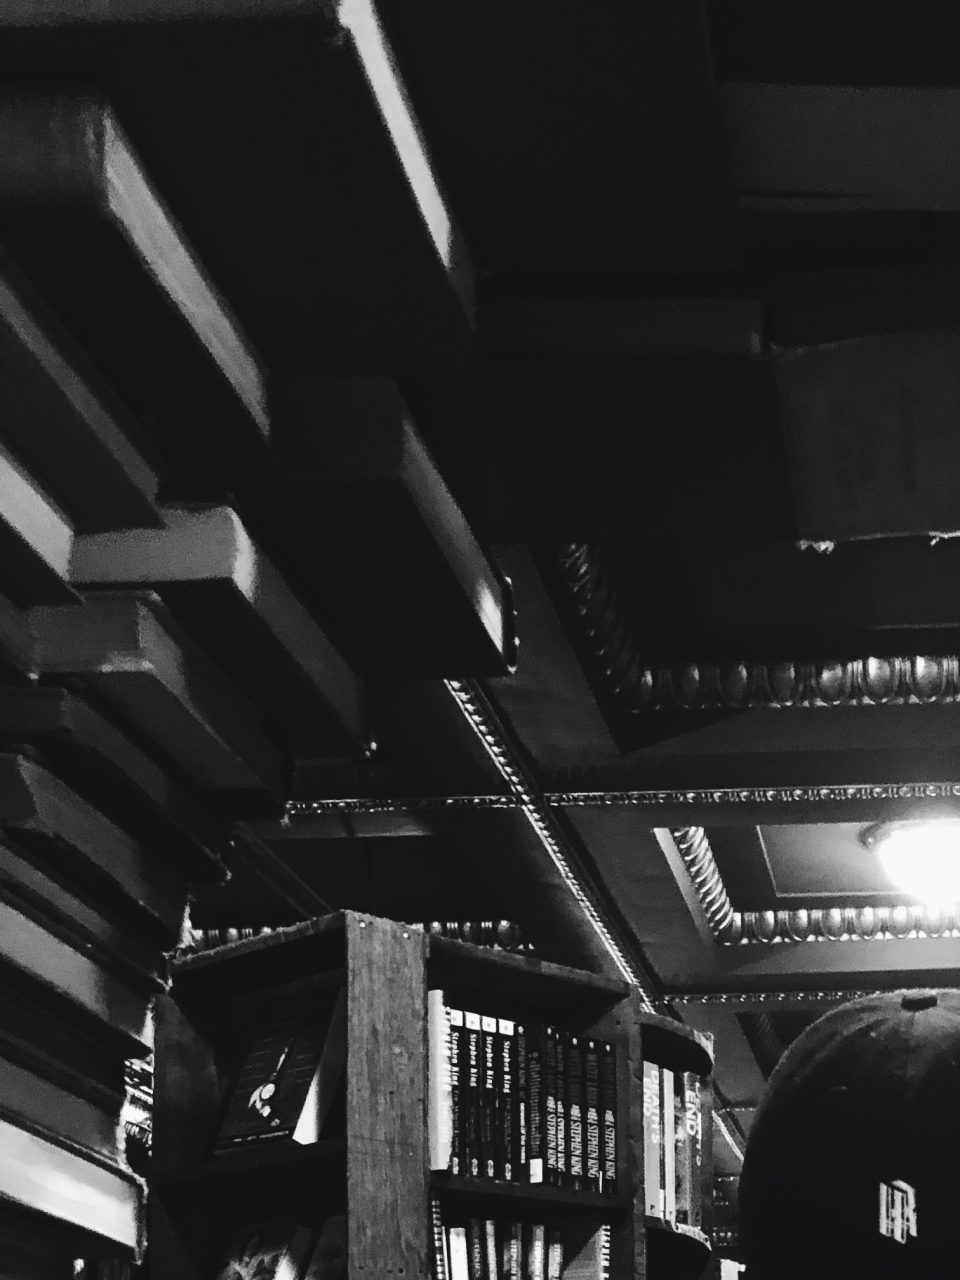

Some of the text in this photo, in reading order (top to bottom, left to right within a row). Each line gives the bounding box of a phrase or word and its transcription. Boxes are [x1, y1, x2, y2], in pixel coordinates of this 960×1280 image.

[451, 1032, 460, 1064] Stephen
[469, 1033, 478, 1065] Stephen
[485, 1035, 494, 1067] Stephen
[502, 1040, 511, 1072] Stephen
[686, 1090, 696, 1136] END
[570, 1121, 582, 1155] STEPHEN
[587, 1124, 599, 1157] STEPHEN
[605, 1127, 615, 1160] STEPHEN
[571, 1156, 582, 1176] KING
[587, 1158, 599, 1178] KING
[605, 1161, 616, 1180] KING
